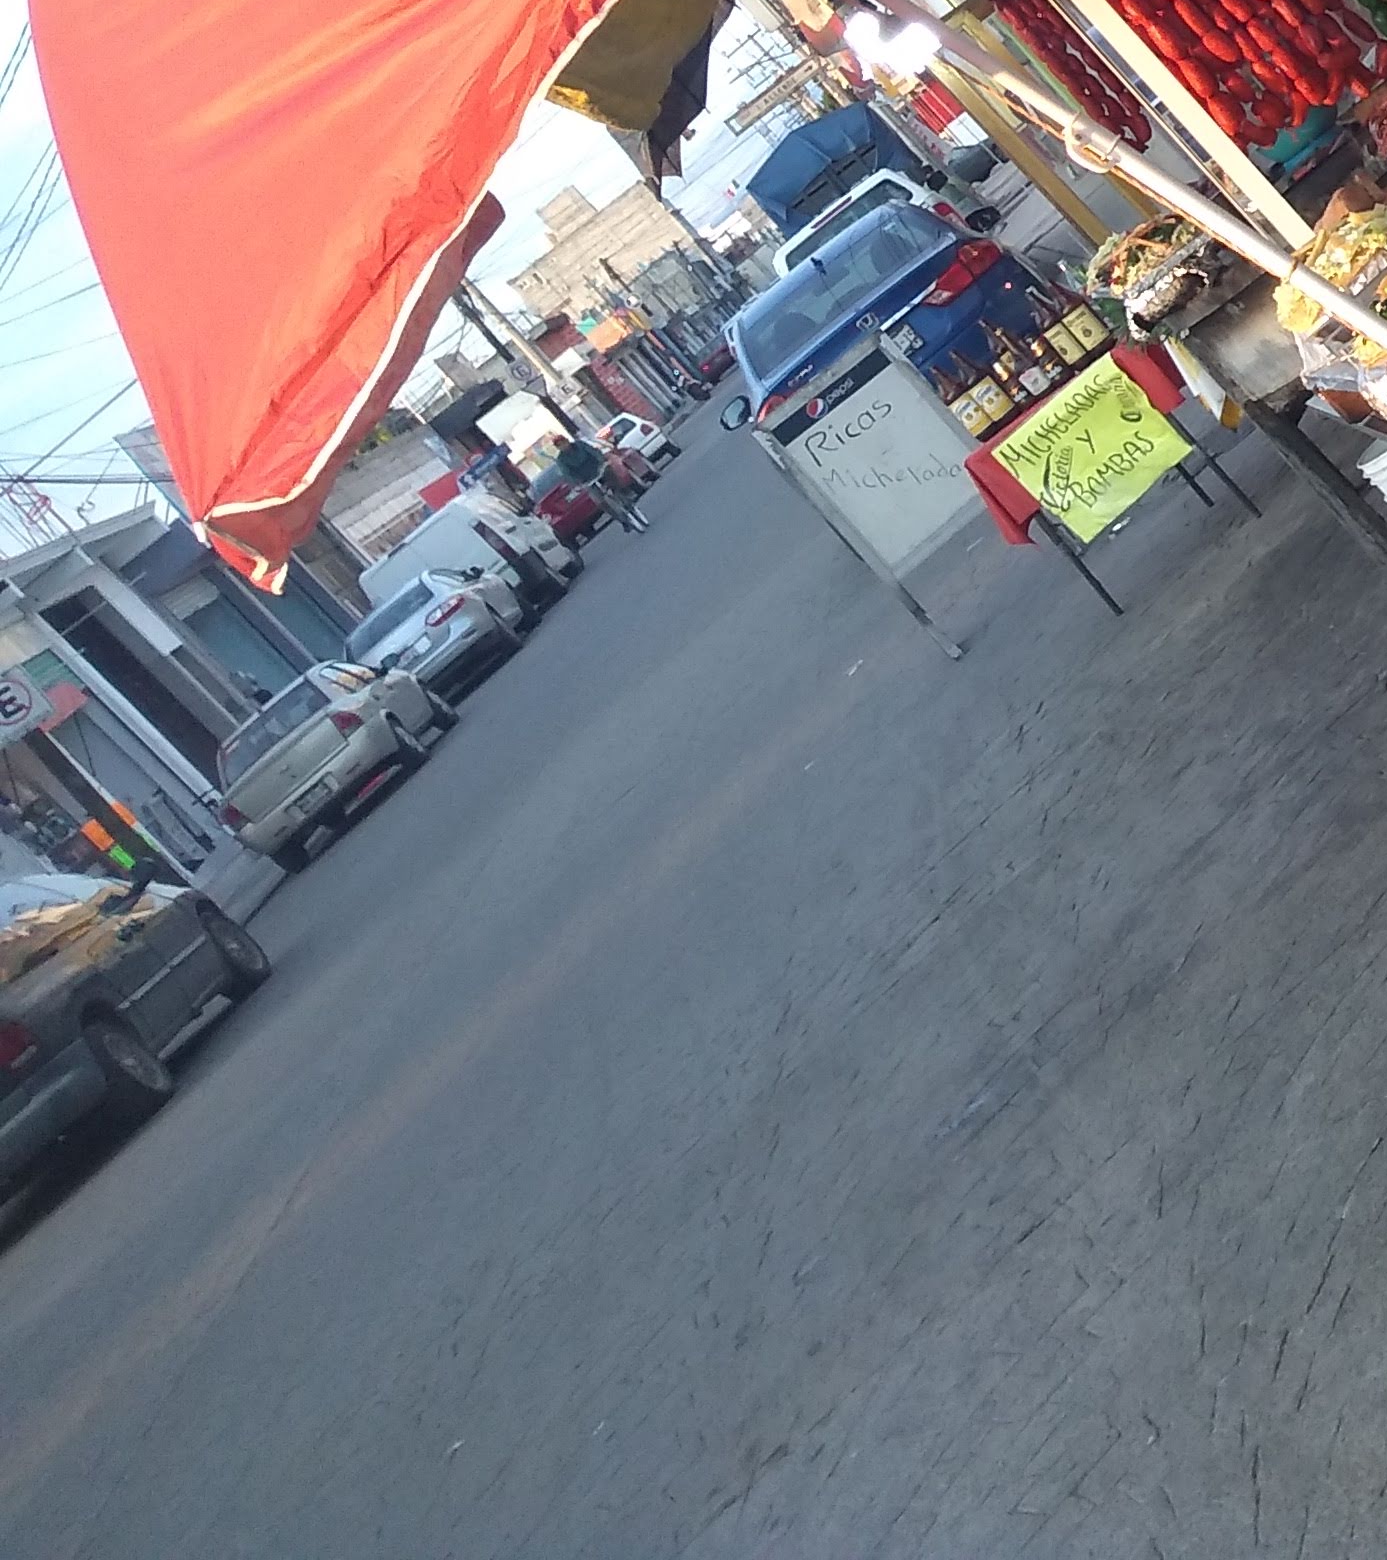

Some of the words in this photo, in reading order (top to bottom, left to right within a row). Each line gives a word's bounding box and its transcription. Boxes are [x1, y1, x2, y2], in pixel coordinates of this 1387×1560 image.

[825, 377, 856, 406] pepsi
[998, 372, 1106, 478] MICHELADAS
[804, 396, 893, 468] Ricas
[1075, 429, 1096, 454] Y
[1039, 443, 1075, 514] Victoria
[1071, 430, 1155, 510] BOMBAS
